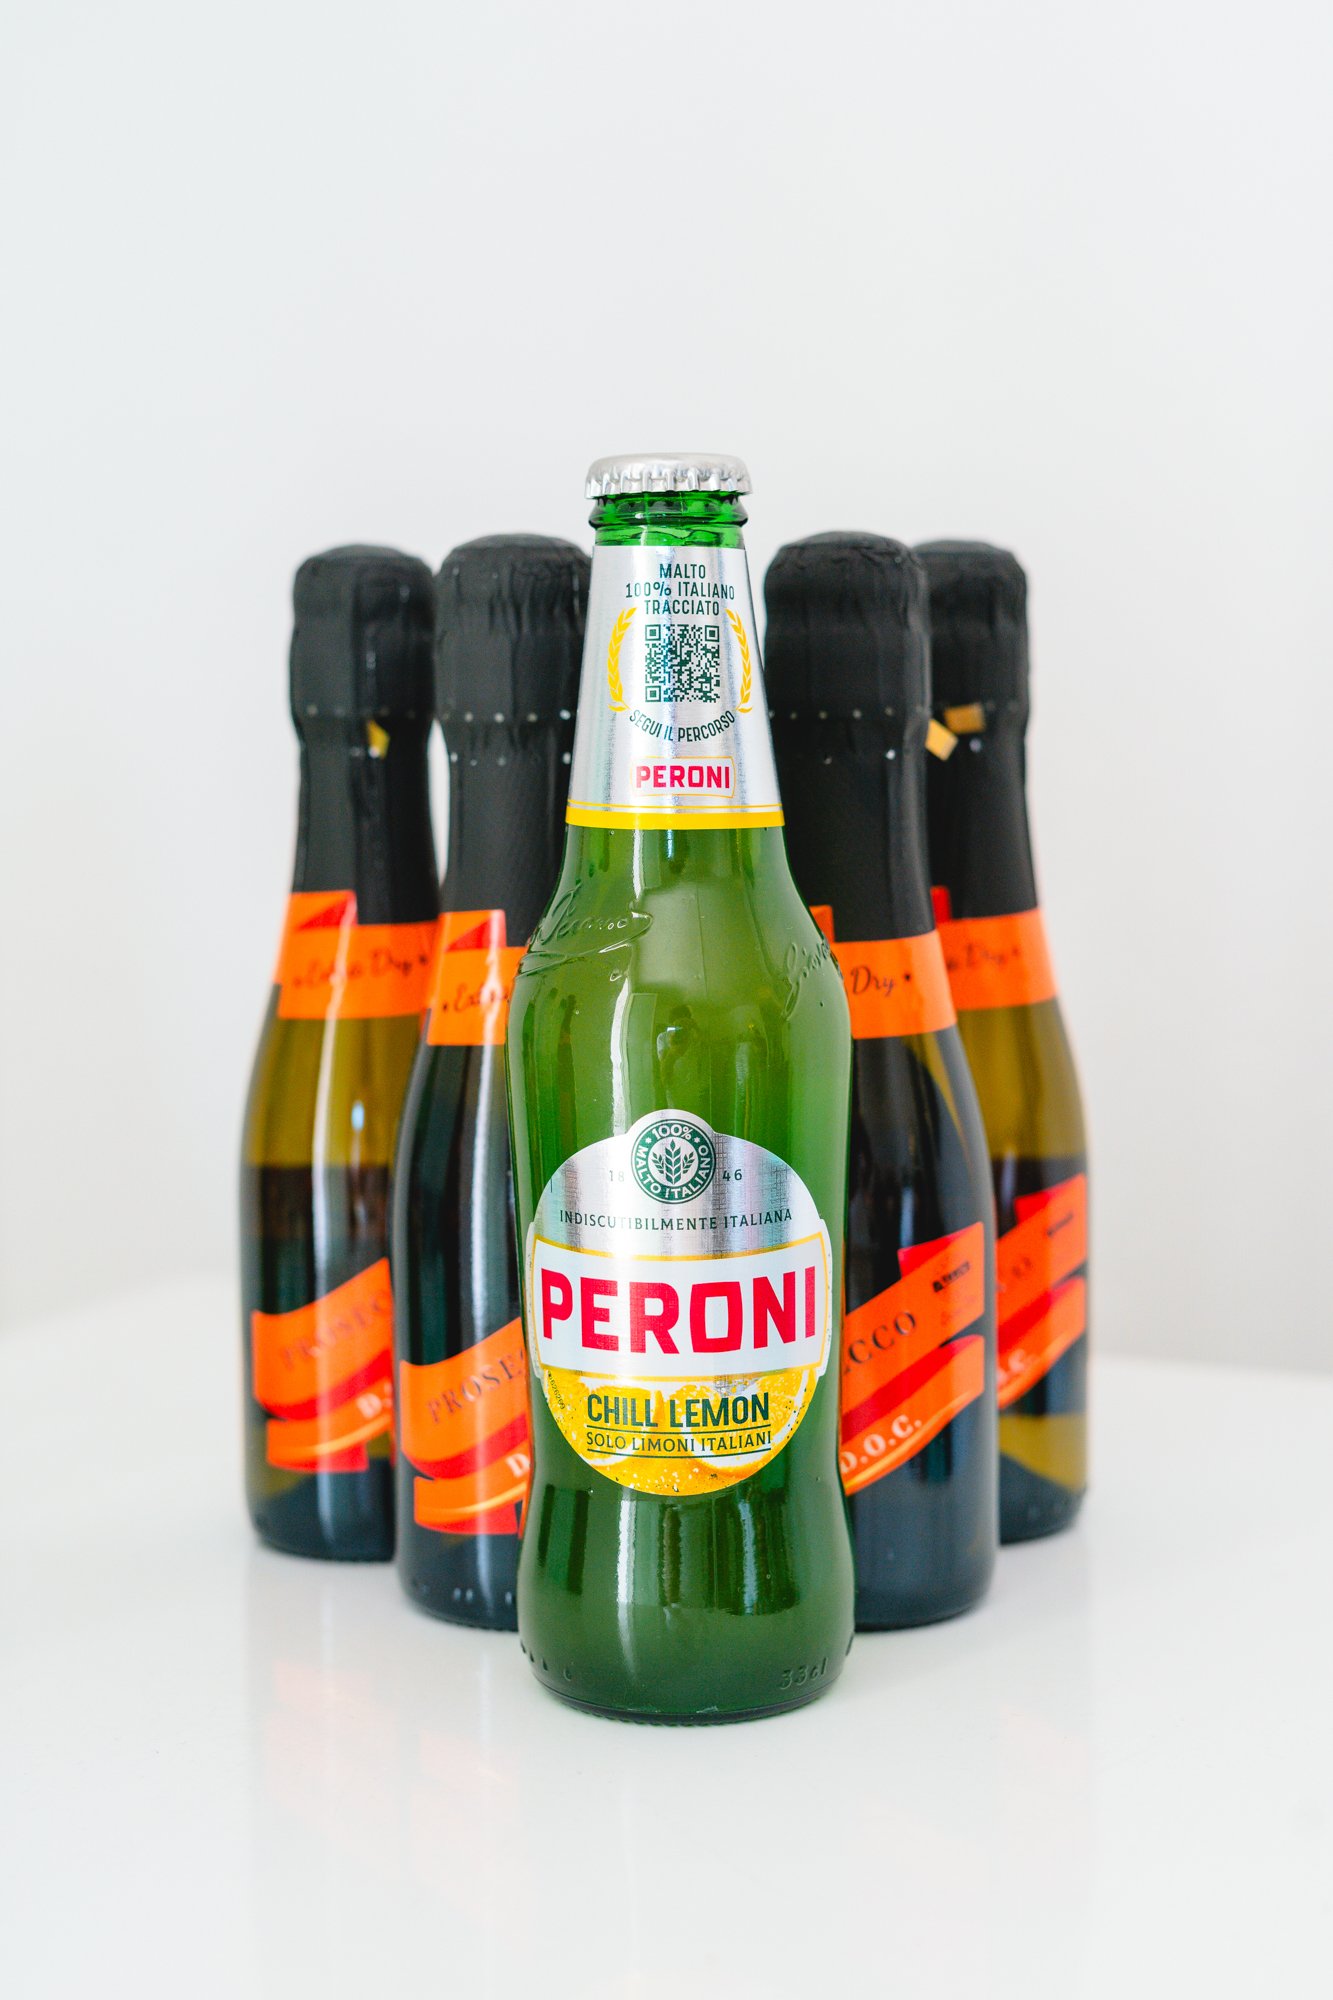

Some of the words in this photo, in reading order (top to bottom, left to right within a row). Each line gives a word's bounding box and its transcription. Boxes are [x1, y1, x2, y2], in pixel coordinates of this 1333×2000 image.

[659, 563, 706, 579] MALTO
[625, 581, 672, 598] 100%
[677, 581, 735, 600] ITALIANO
[644, 600, 720, 616] TRACCIATO
[629, 709, 663, 738] SEGUI
[663, 725, 674, 741] IL
[677, 710, 736, 742] PERCORSO
[635, 765, 731, 789] PERONI
[850, 965, 896, 997] Dry
[651, 1123, 694, 1141] 100%
[609, 1169, 625, 1182] 18
[722, 1168, 743, 1182] 46
[635, 1144, 662, 1194] MALTO
[664, 1144, 711, 1199] ITALIANO
[560, 1209, 718, 1231] INDISCUTIBILMENTE
[724, 1208, 792, 1229] ITALIANA
[541, 1265, 816, 1355] PERONI
[843, 1312, 916, 1374] CCO
[428, 1348, 524, 1423] PROSE
[587, 1393, 659, 1428] CHILL
[669, 1392, 769, 1428] LEMON
[586, 1431, 626, 1450] SOLO
[632, 1437, 695, 1453] LIMONI
[701, 1430, 771, 1452] ITALIANI
